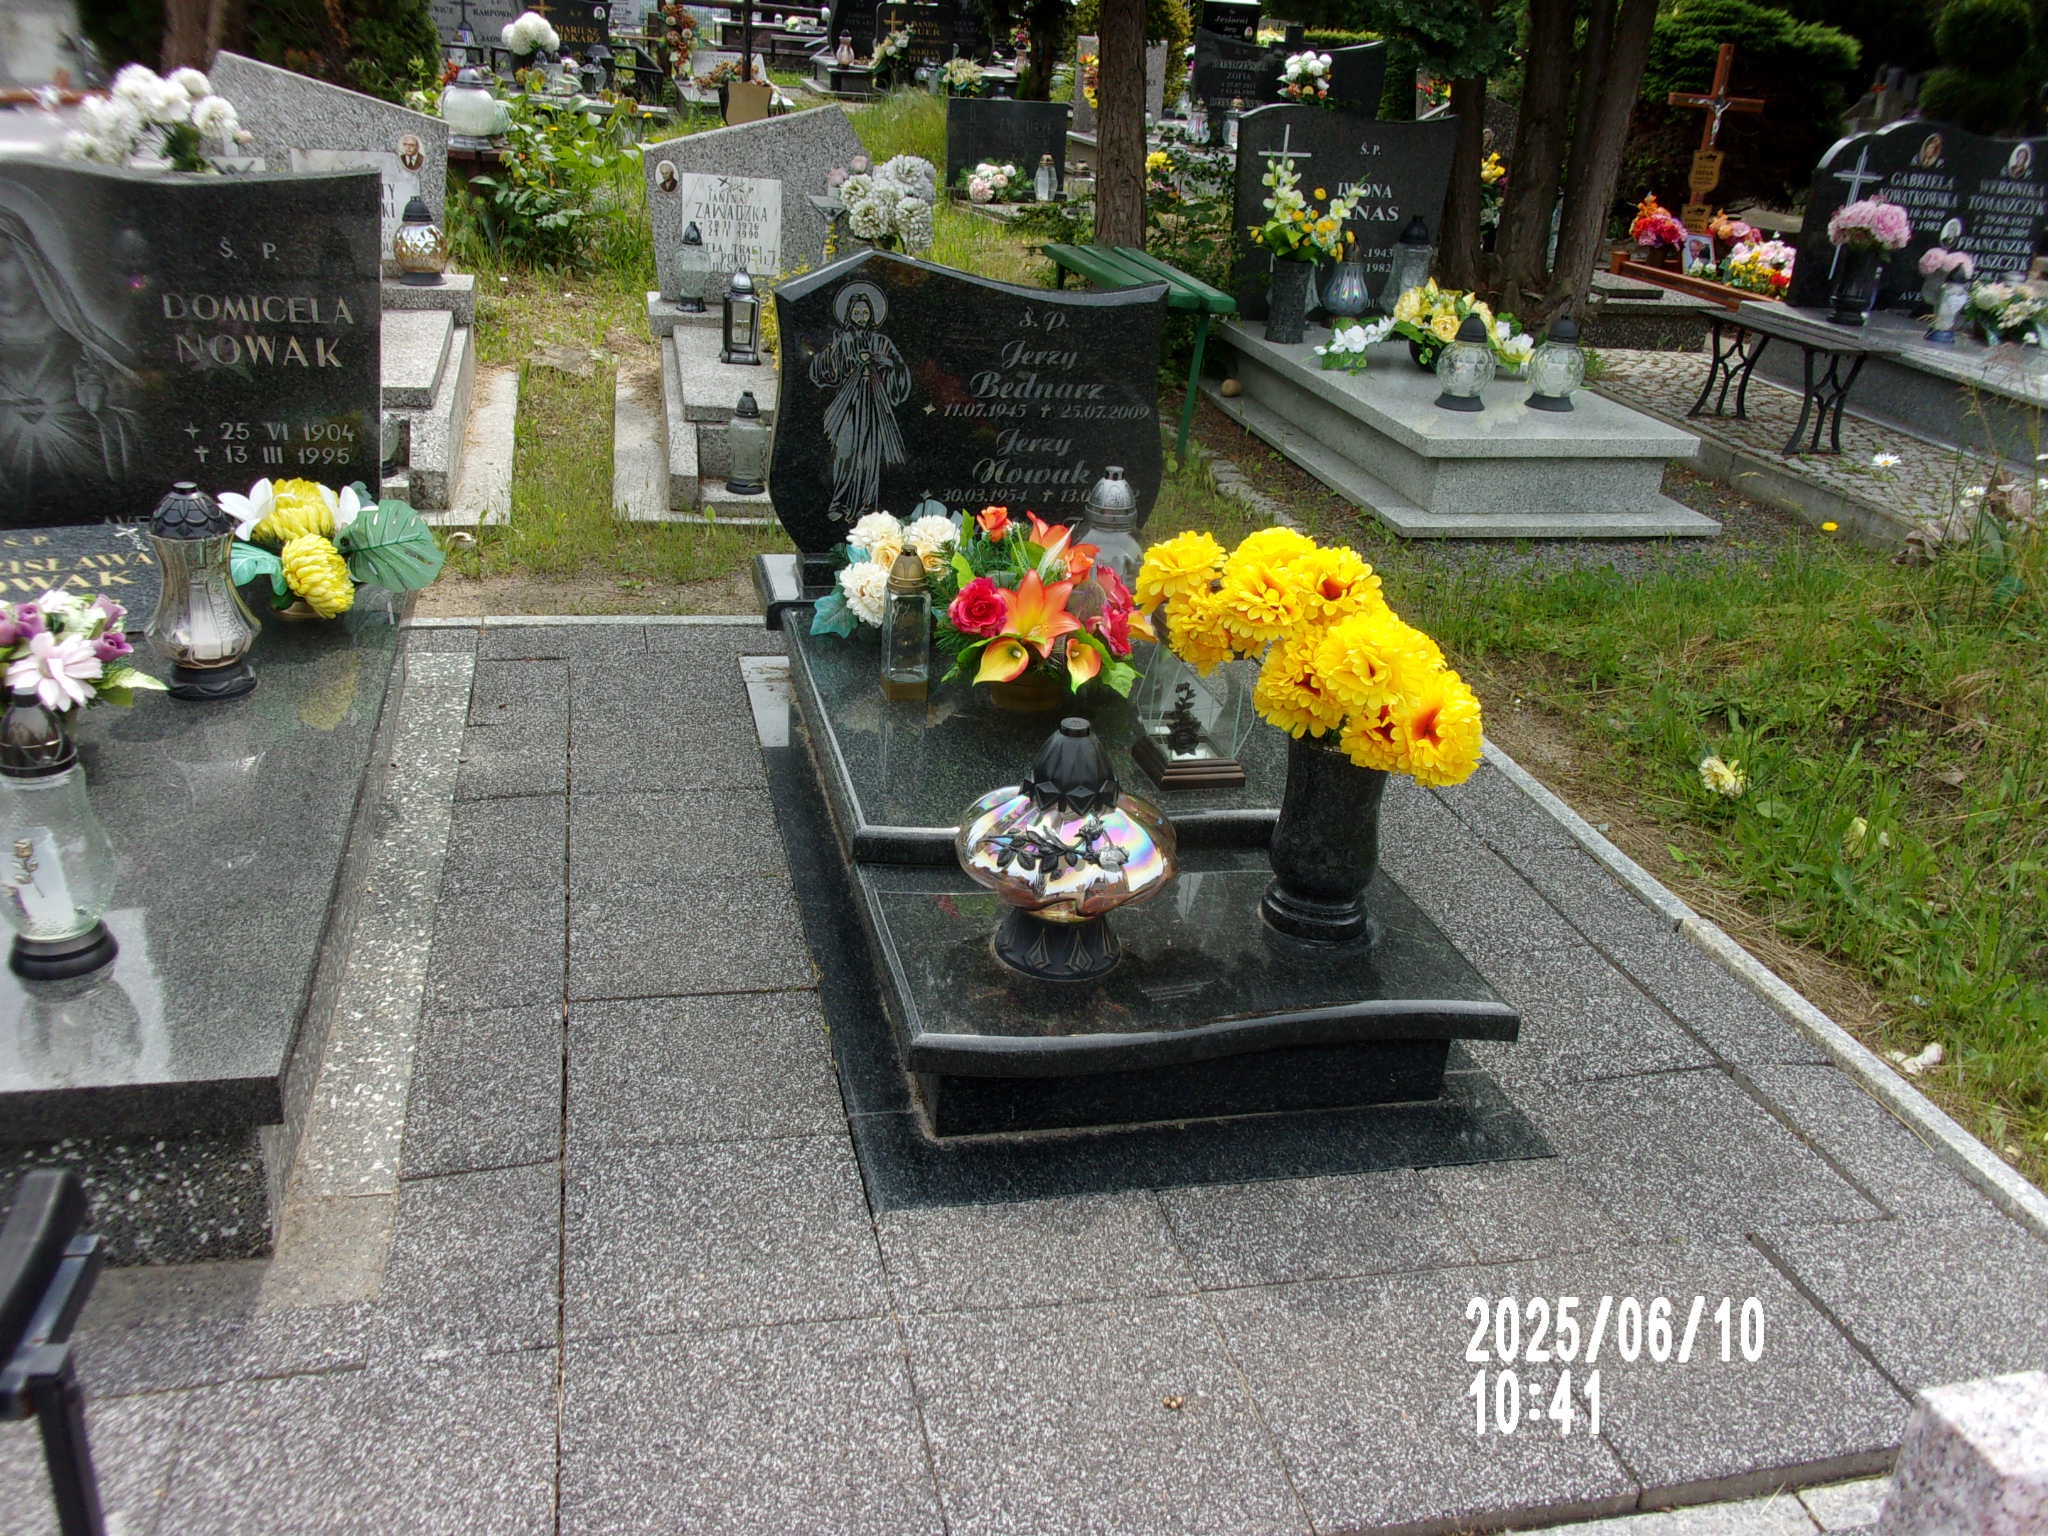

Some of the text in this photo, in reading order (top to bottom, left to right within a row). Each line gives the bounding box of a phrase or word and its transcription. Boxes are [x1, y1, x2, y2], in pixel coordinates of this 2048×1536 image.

[1372, 144, 1382, 156] P.
[695, 202, 768, 222] ZAWADZKA
[1967, 195, 2047, 216] TOMASZCZYK
[262, 242, 280, 261] P.
[1955, 236, 2034, 254] FRANCISZEK
[1973, 253, 2031, 272] ASZCZYK
[161, 292, 354, 325] DOMICELA
[175, 333, 343, 368] NOWAK
[1000, 339, 1078, 369] Jerzy
[969, 369, 1105, 400] Bednarz
[943, 403, 1150, 419] 11.07.1945 25.07.2009
[219, 422, 355, 442] 25 VI 1904
[996, 428, 1073, 456] Jerzy
[225, 446, 351, 465] 13 III 1995
[972, 457, 1091, 484] Nowak
[943, 488, 1029, 503] 30.03.1954
